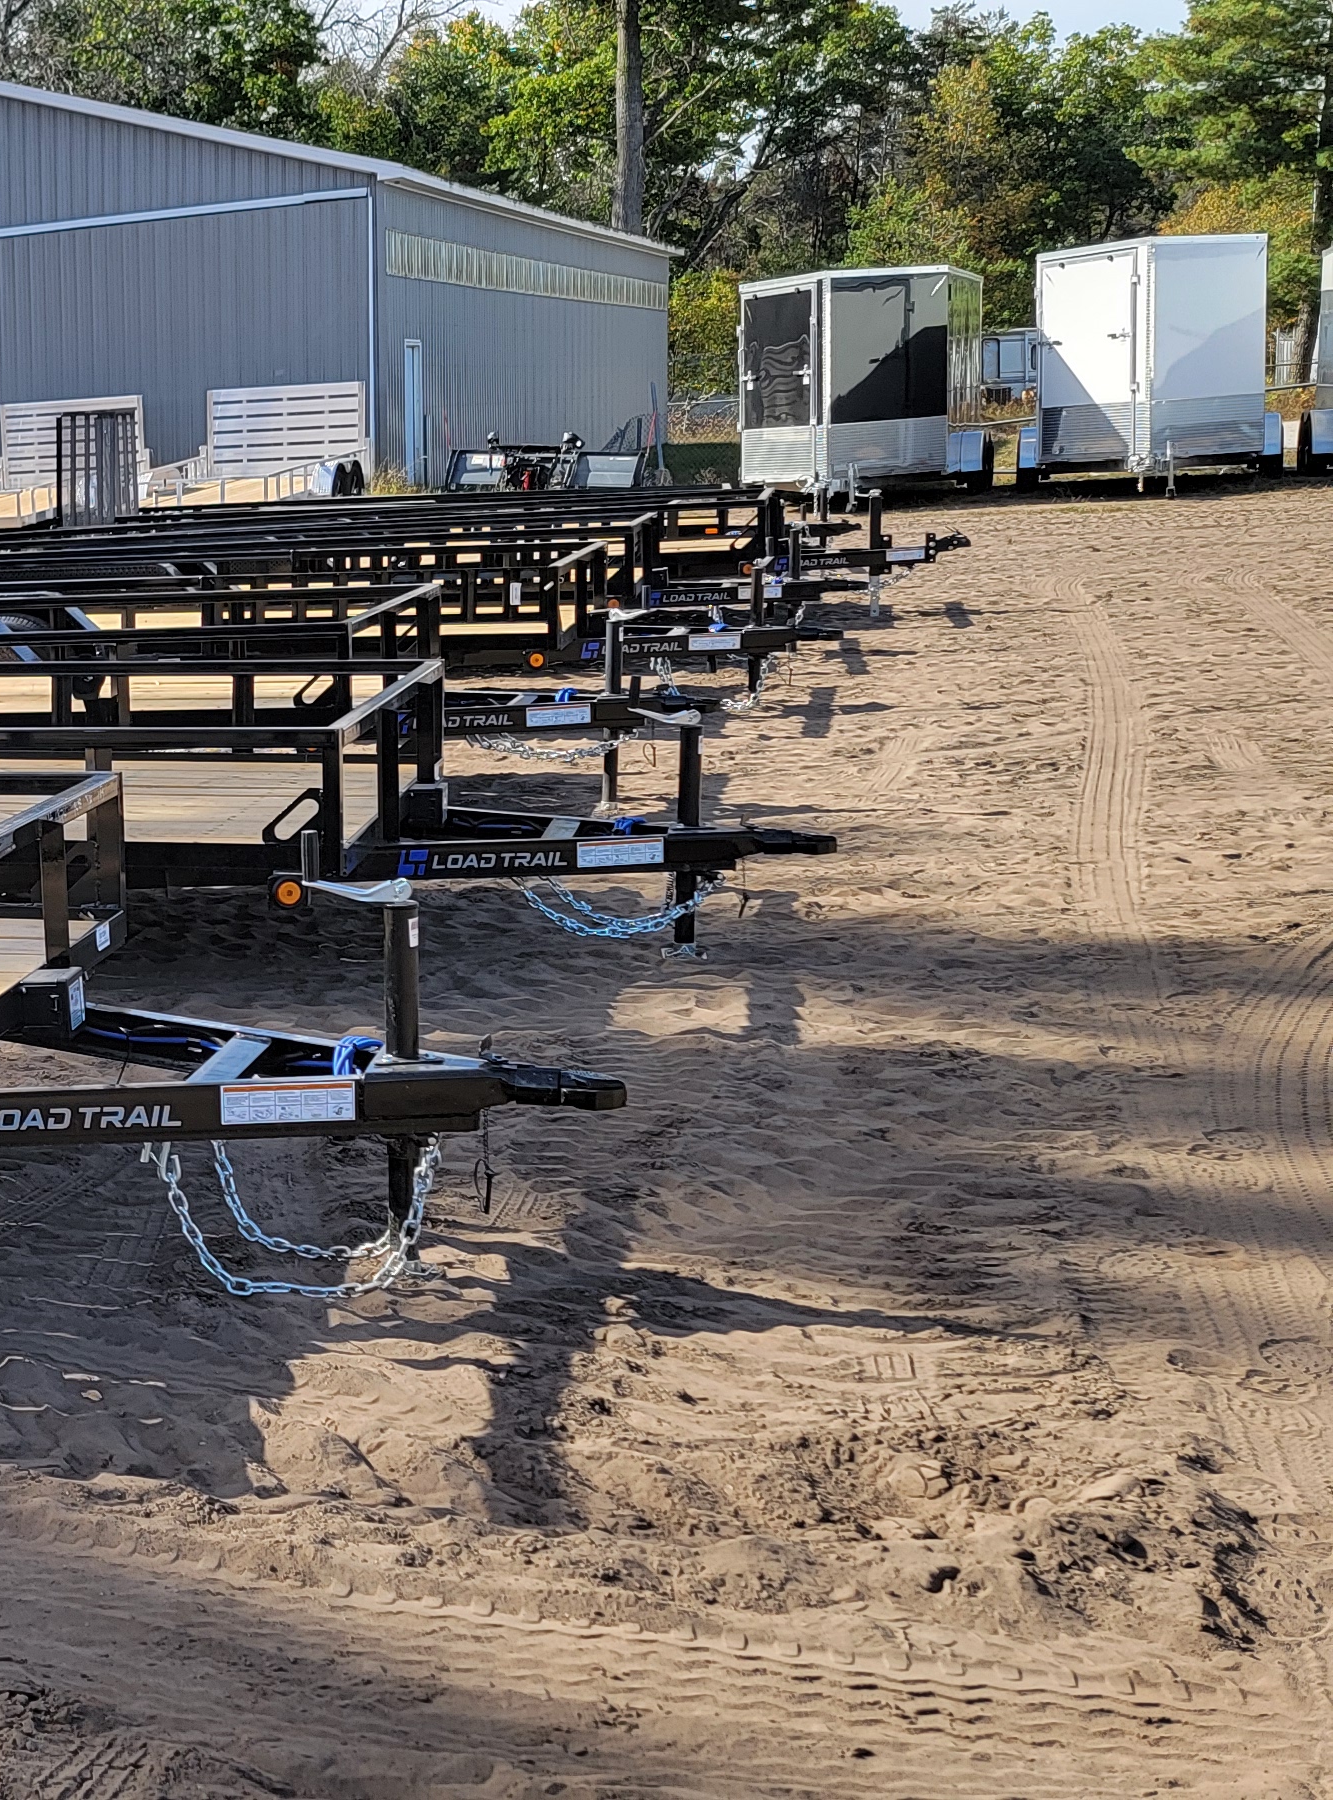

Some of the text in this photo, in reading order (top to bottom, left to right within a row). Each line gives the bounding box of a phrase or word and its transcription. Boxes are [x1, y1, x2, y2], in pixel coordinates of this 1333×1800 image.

[662, 593, 695, 603] LOAD
[696, 592, 732, 602] TRAIL
[641, 641, 683, 653] TRAIL
[463, 714, 514, 727] TRAIL
[431, 853, 496, 869] LOAD
[500, 851, 568, 868] TRAIL
[78, 1104, 182, 1129] TRAIL
